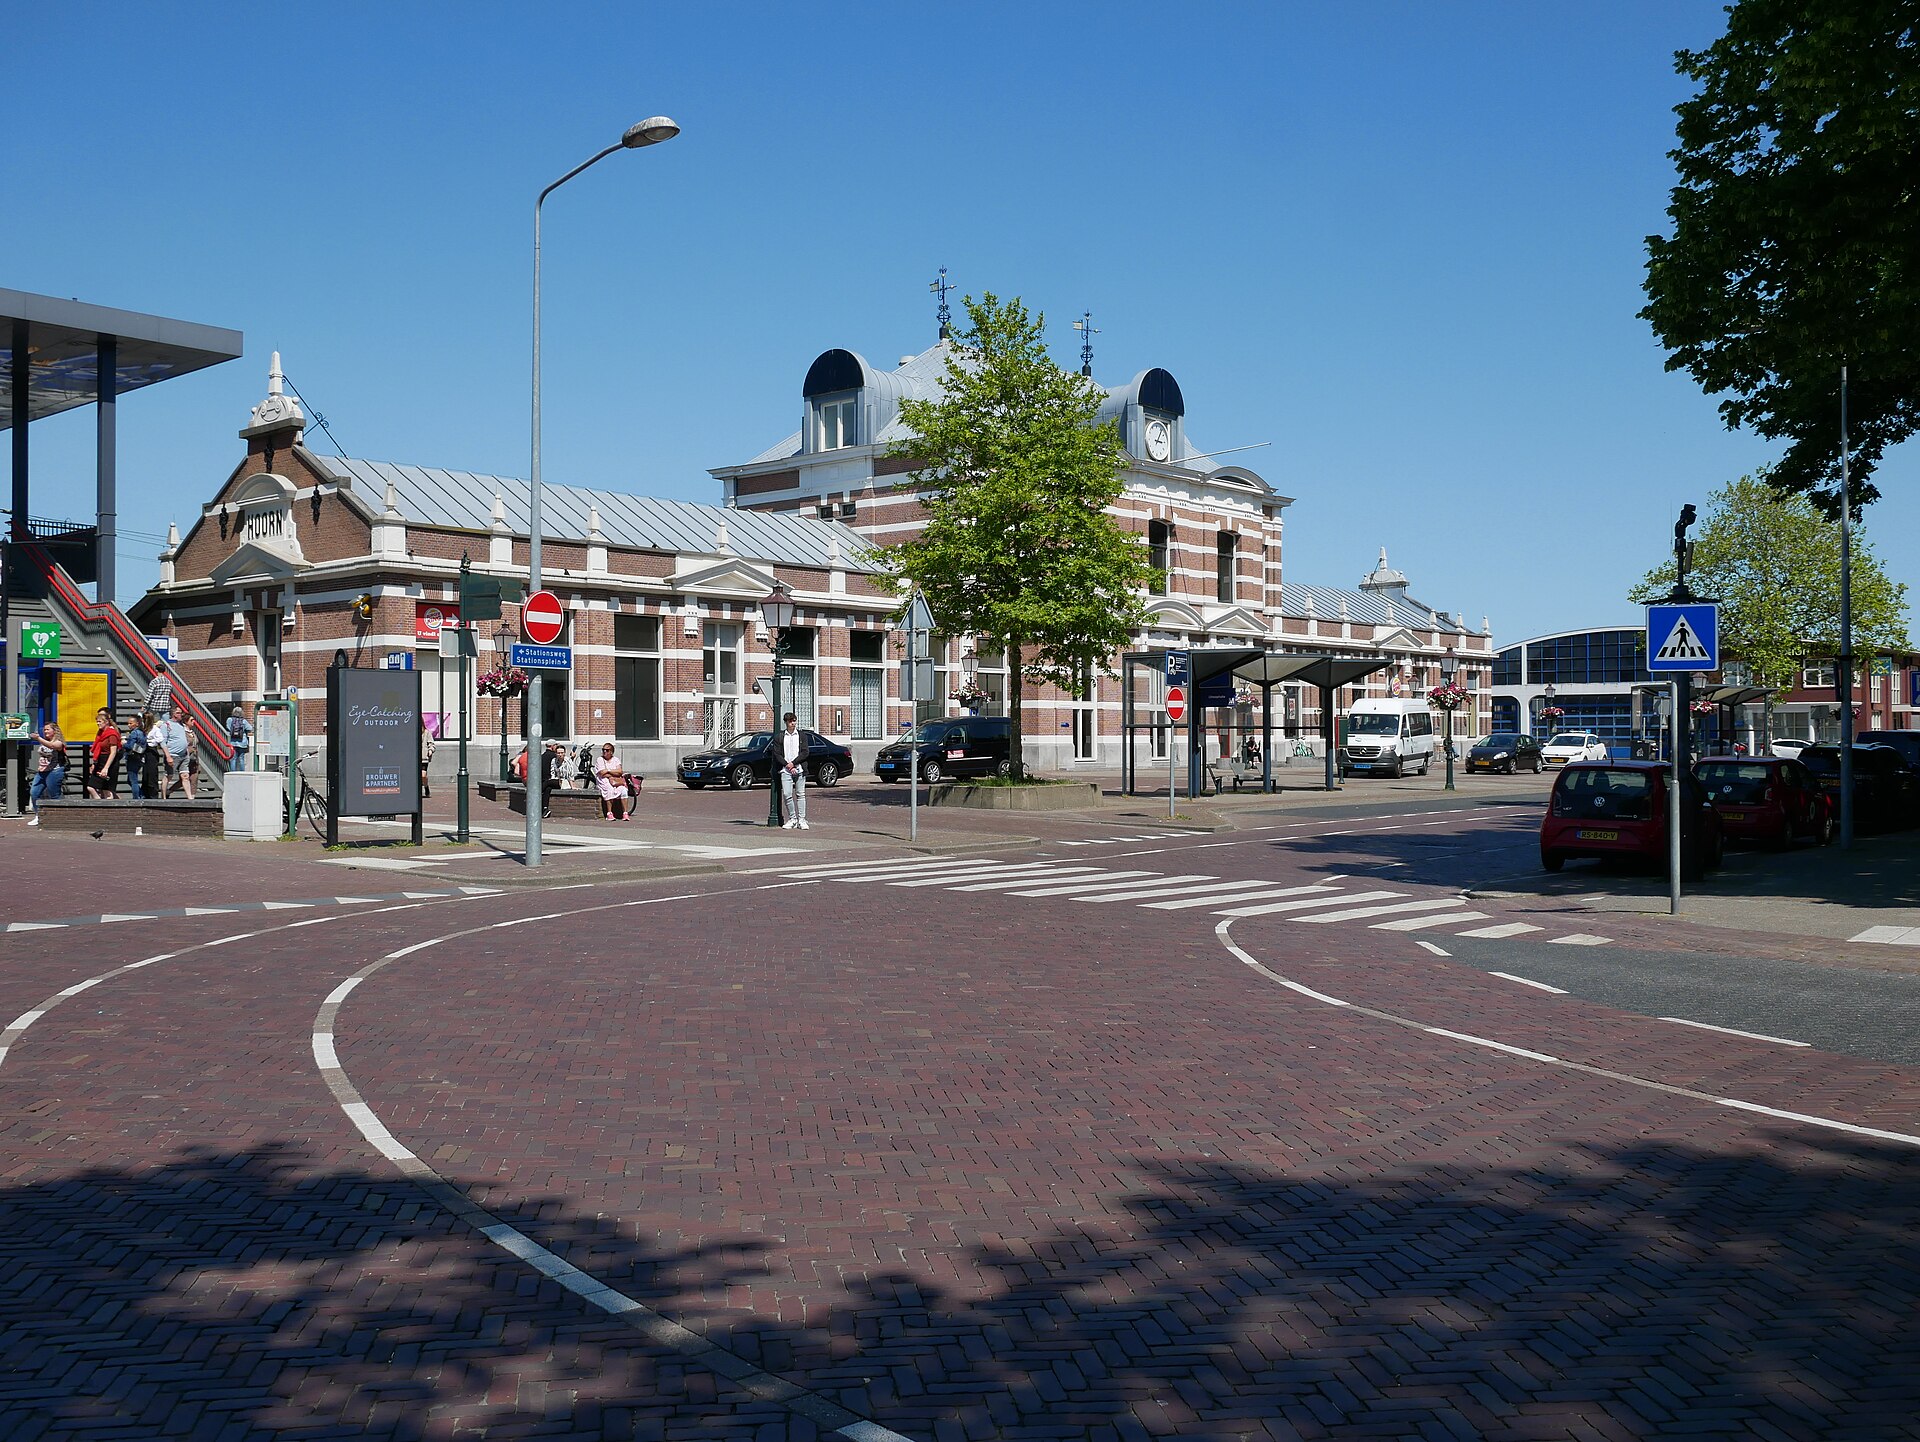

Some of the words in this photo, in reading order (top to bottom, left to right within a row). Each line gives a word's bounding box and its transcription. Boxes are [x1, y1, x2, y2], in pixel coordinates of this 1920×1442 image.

[247, 509, 283, 540] HOORN
[30, 648, 52, 656] AED
[525, 648, 566, 659] Stationsweg
[516, 656, 561, 666] Stationsplein
[365, 773, 398, 781] BROUWER
